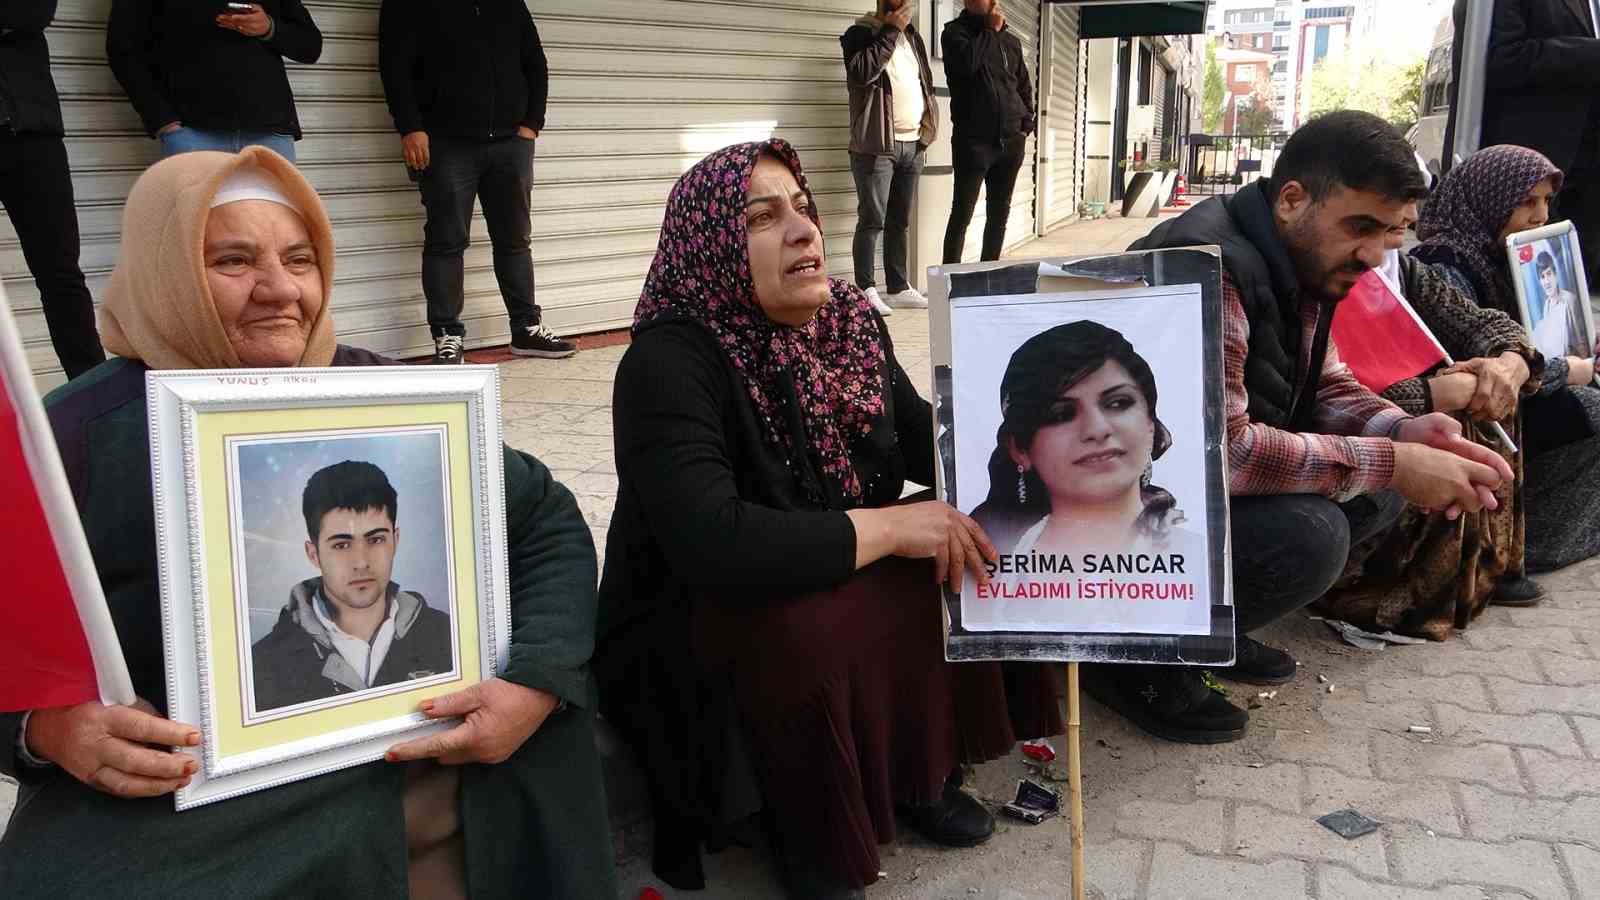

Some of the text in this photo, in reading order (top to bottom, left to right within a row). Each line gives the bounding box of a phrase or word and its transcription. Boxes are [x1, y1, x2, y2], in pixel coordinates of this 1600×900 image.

[984, 549, 1185, 578] ŞERİMA SANCAR
[976, 578, 1194, 600] EVLADIMI İSTİYORUM!
